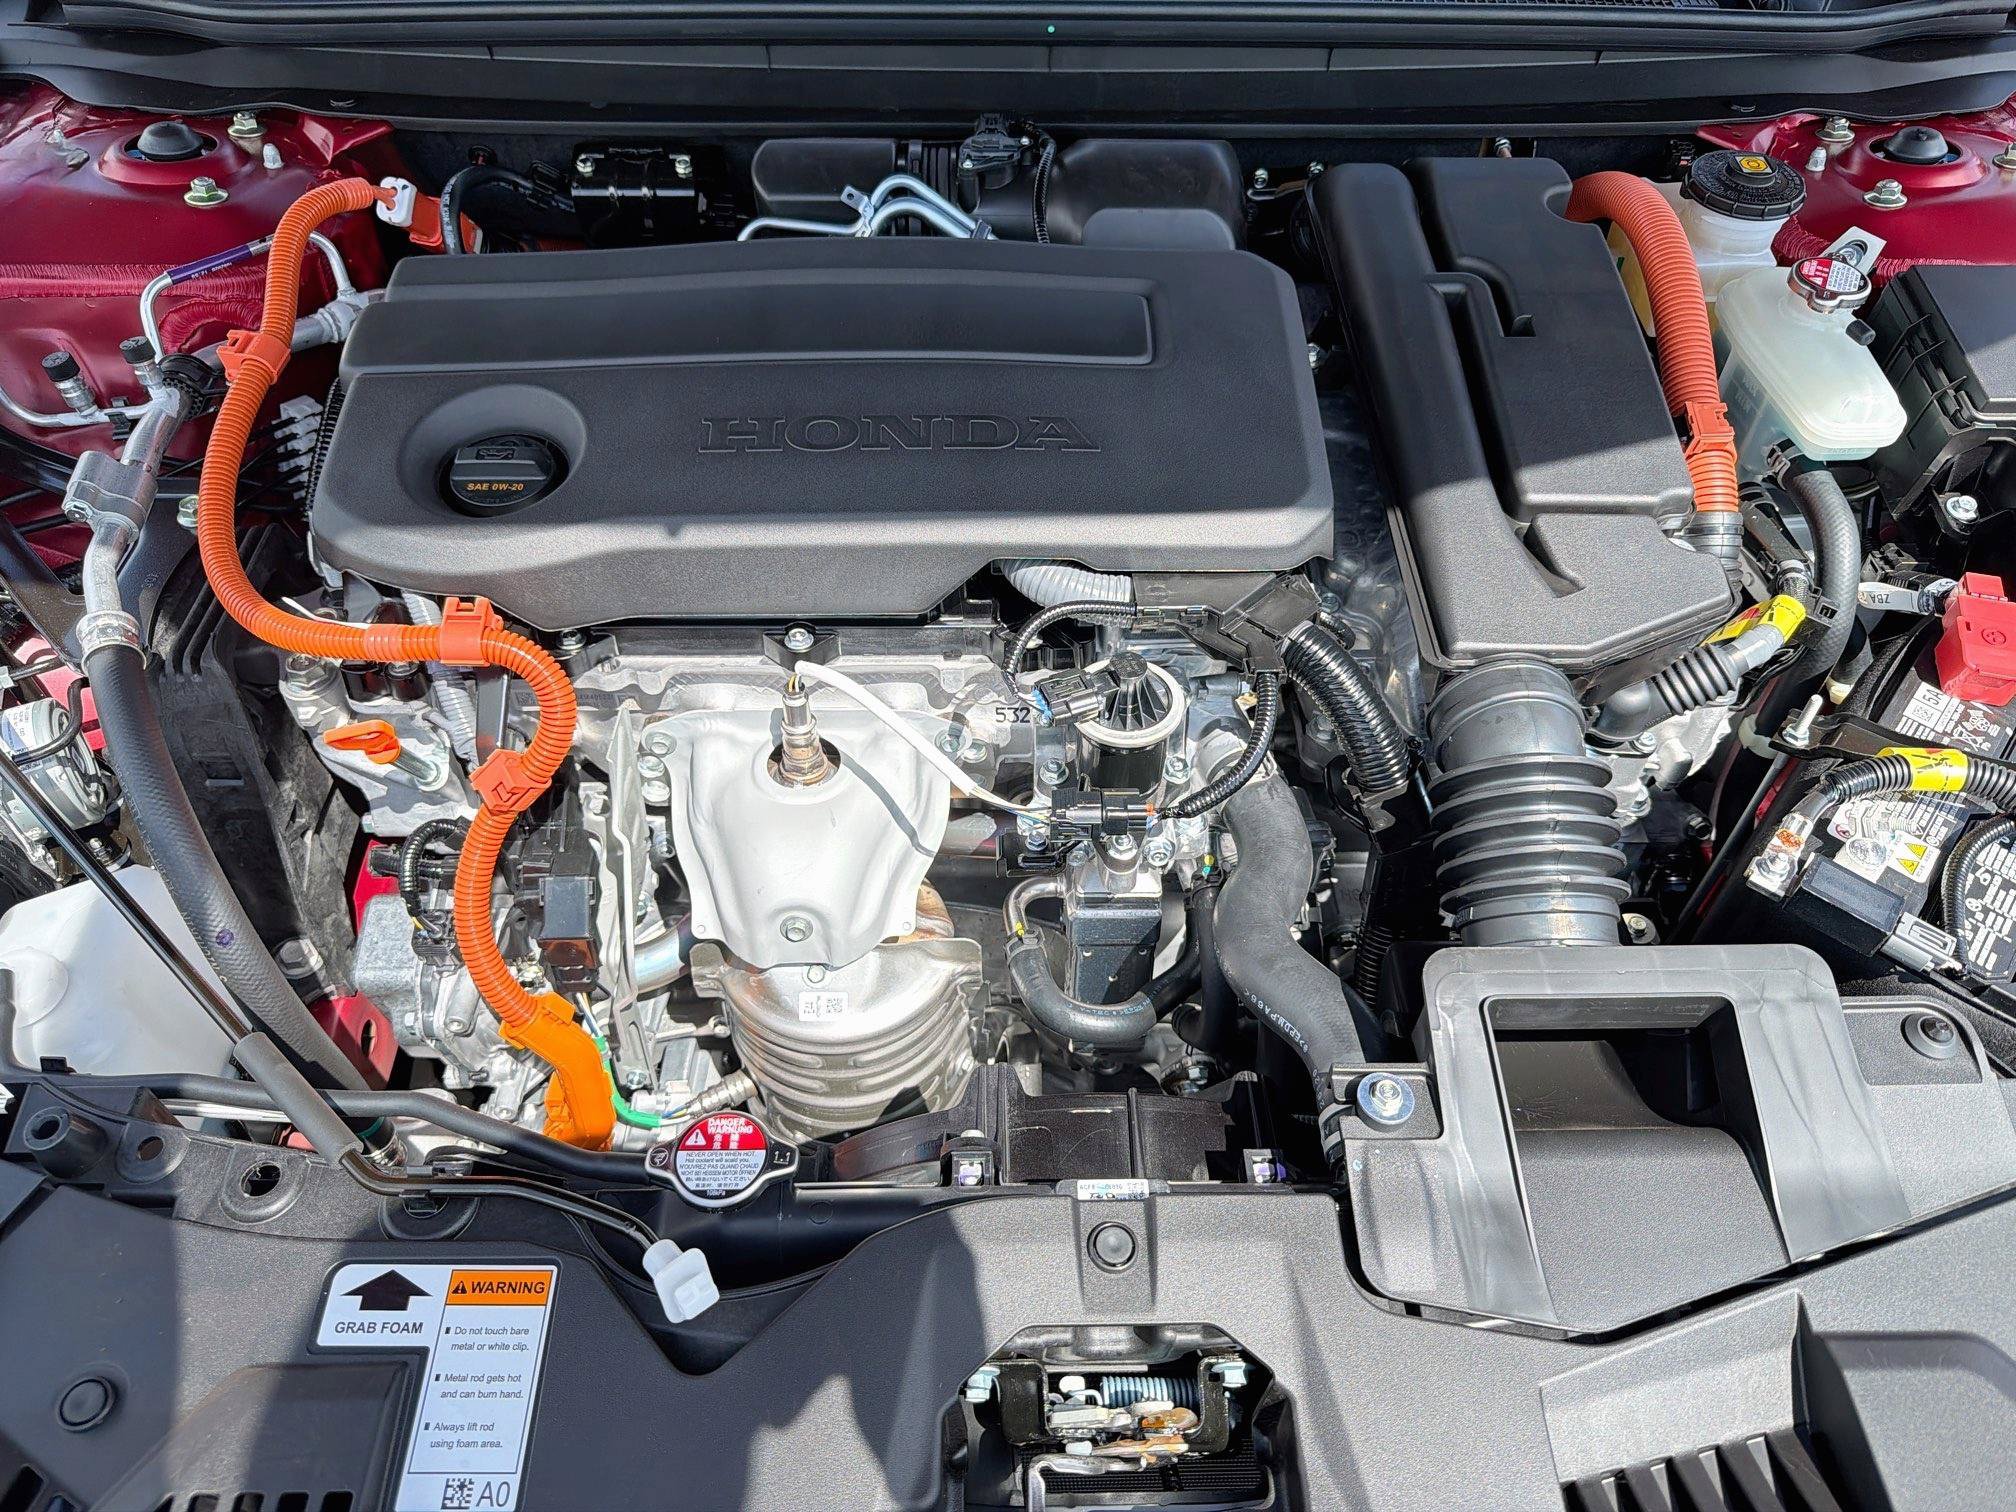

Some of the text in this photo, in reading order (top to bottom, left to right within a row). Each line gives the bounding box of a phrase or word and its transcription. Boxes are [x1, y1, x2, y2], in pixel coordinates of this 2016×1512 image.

[699, 414, 1101, 452] HONDA
[466, 483, 525, 491] SAE 0W-20
[996, 707, 1030, 723] 532
[708, 1117, 746, 1126] DANGER
[708, 1125, 753, 1134] WARNING
[471, 1281, 546, 1294] WARNING
[334, 1321, 424, 1334] GRAB FOAM
[454, 1327, 530, 1336] Do not touch bare
[451, 1342, 475, 1351] metal
[487, 1342, 511, 1351] white
[512, 1342, 530, 1353] clip.
[444, 1373, 522, 1385] Metal rod gets hot
[440, 1389, 524, 1399] and can burn hand.
[433, 1422, 495, 1433] Always lift rod
[430, 1439, 454, 1450] using
[456, 1439, 479, 1448] foam
[475, 1481, 511, 1508] A0
